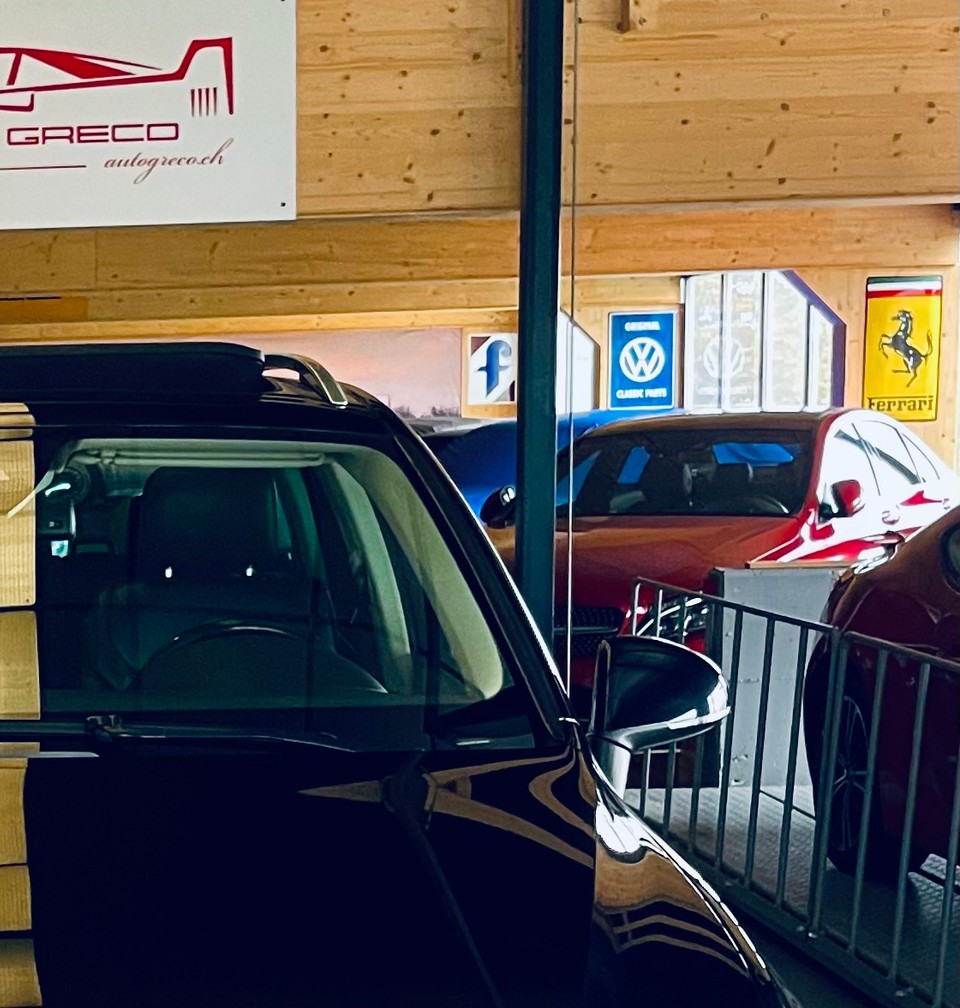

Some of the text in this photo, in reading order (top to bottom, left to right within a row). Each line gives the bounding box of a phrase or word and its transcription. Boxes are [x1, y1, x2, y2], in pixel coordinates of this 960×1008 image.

[6, 122, 180, 146] GRECO
[103, 137, 235, 185] autogreco.ch
[867, 395, 934, 412] Ferrari
